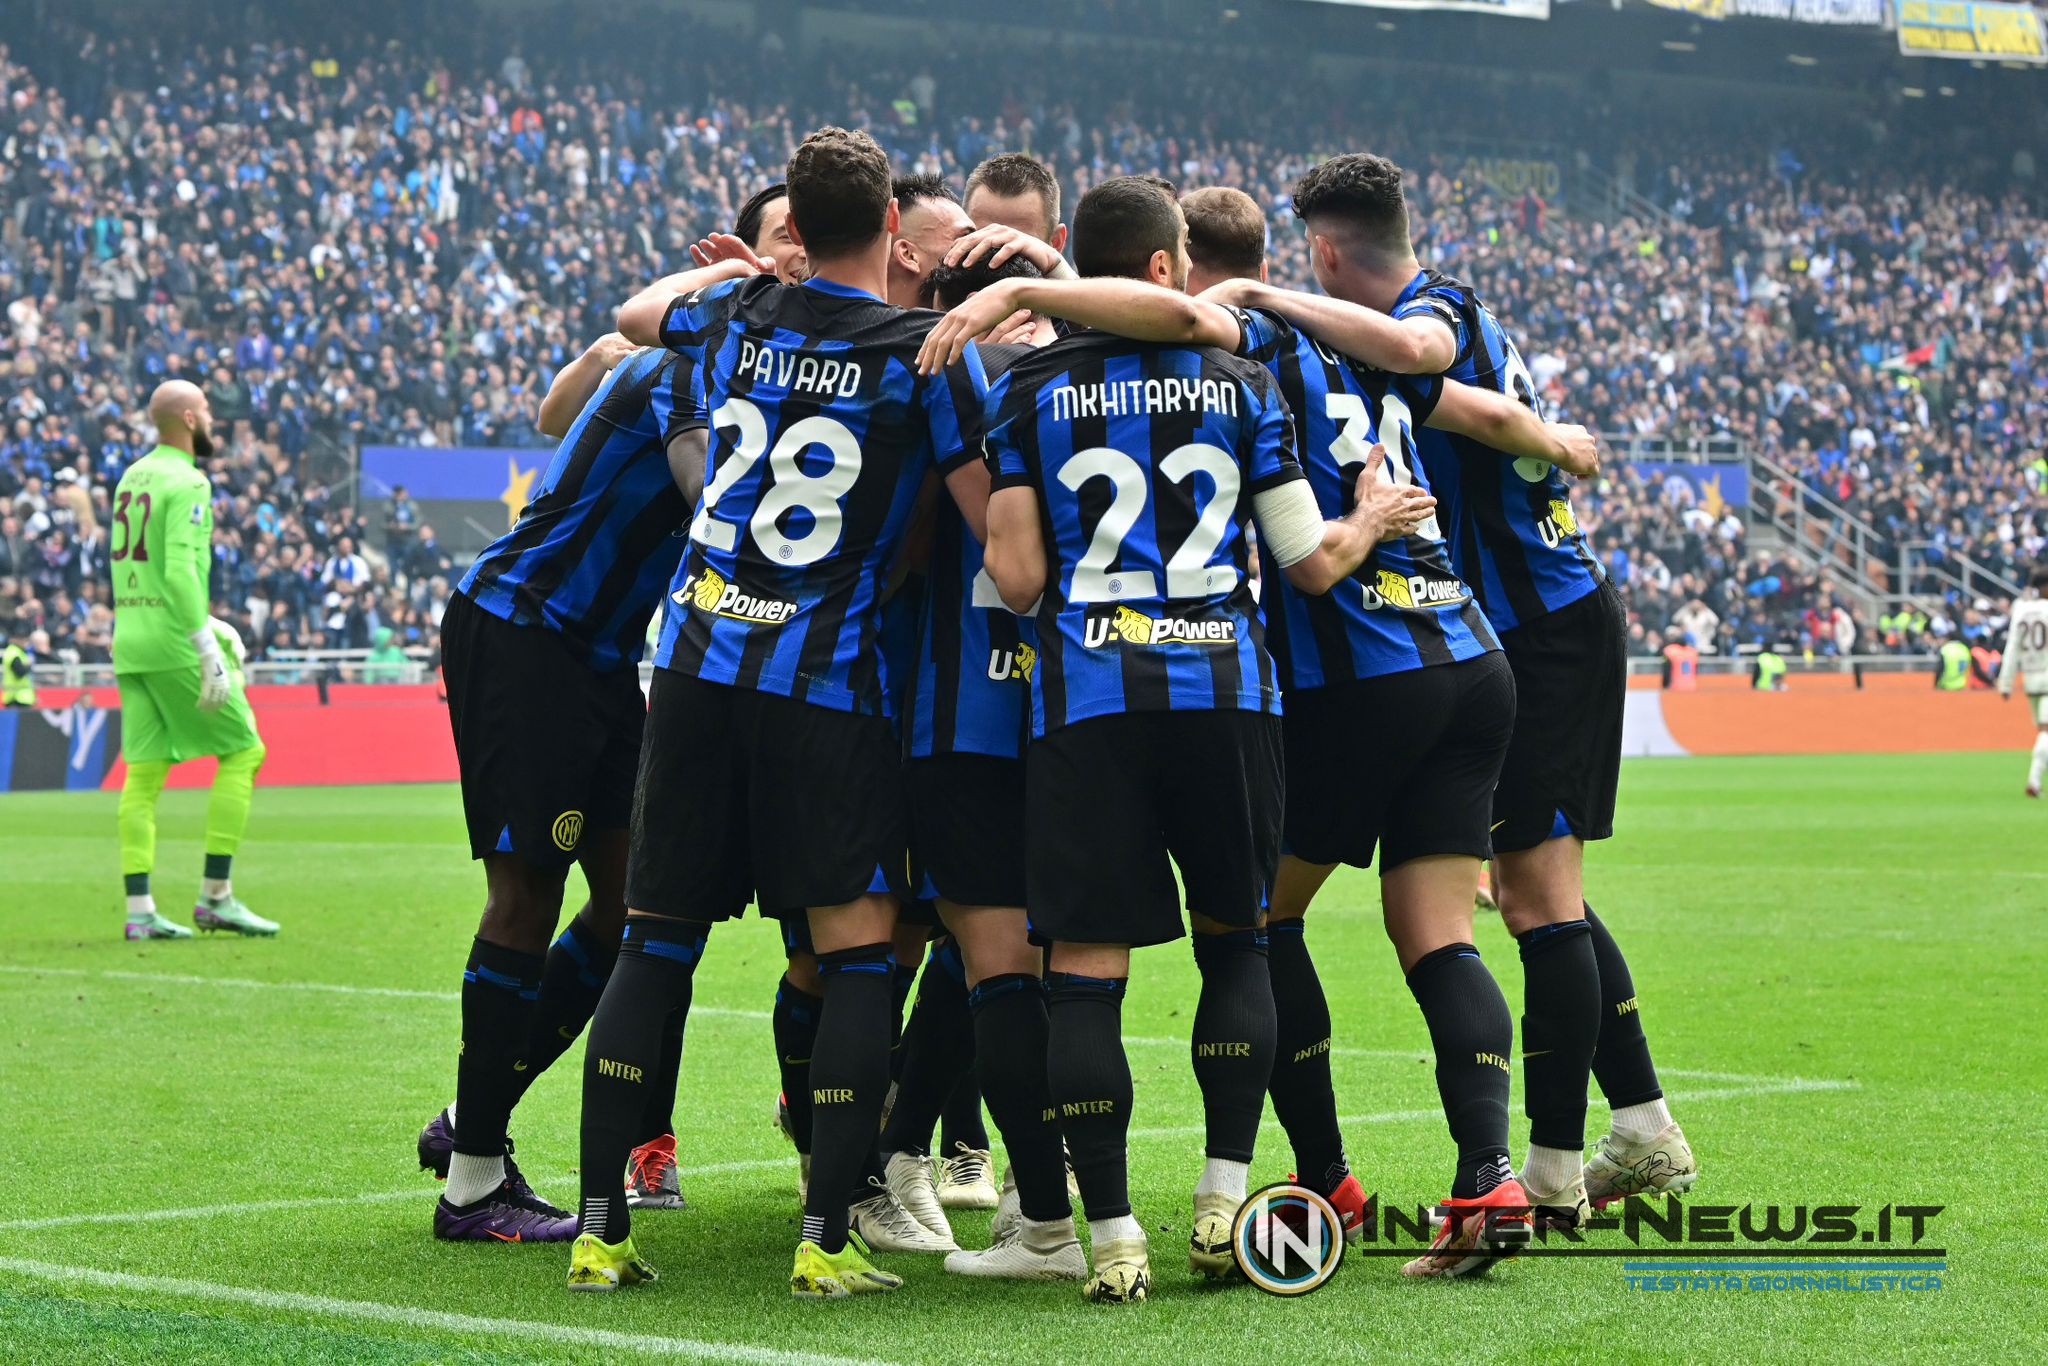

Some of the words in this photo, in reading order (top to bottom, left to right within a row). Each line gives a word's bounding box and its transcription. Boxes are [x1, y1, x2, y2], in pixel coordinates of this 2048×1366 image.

[738, 341, 862, 397] PAVARD
[1052, 378, 1238, 422] MKHITARYAN
[689, 398, 862, 565] 28
[111, 490, 151, 561] 32
[1057, 443, 1241, 603] 22
[711, 584, 798, 621] Power
[1408, 576, 1461, 608] Power
[1149, 619, 1234, 644] Power
[1198, 1042, 1251, 1057] INTER
[1294, 1037, 1331, 1063] INTER
[1475, 1052, 1510, 1076] INTER
[598, 1058, 643, 1084] INTER
[813, 1088, 854, 1105] INTER
[1062, 1100, 1113, 1117] INTER
